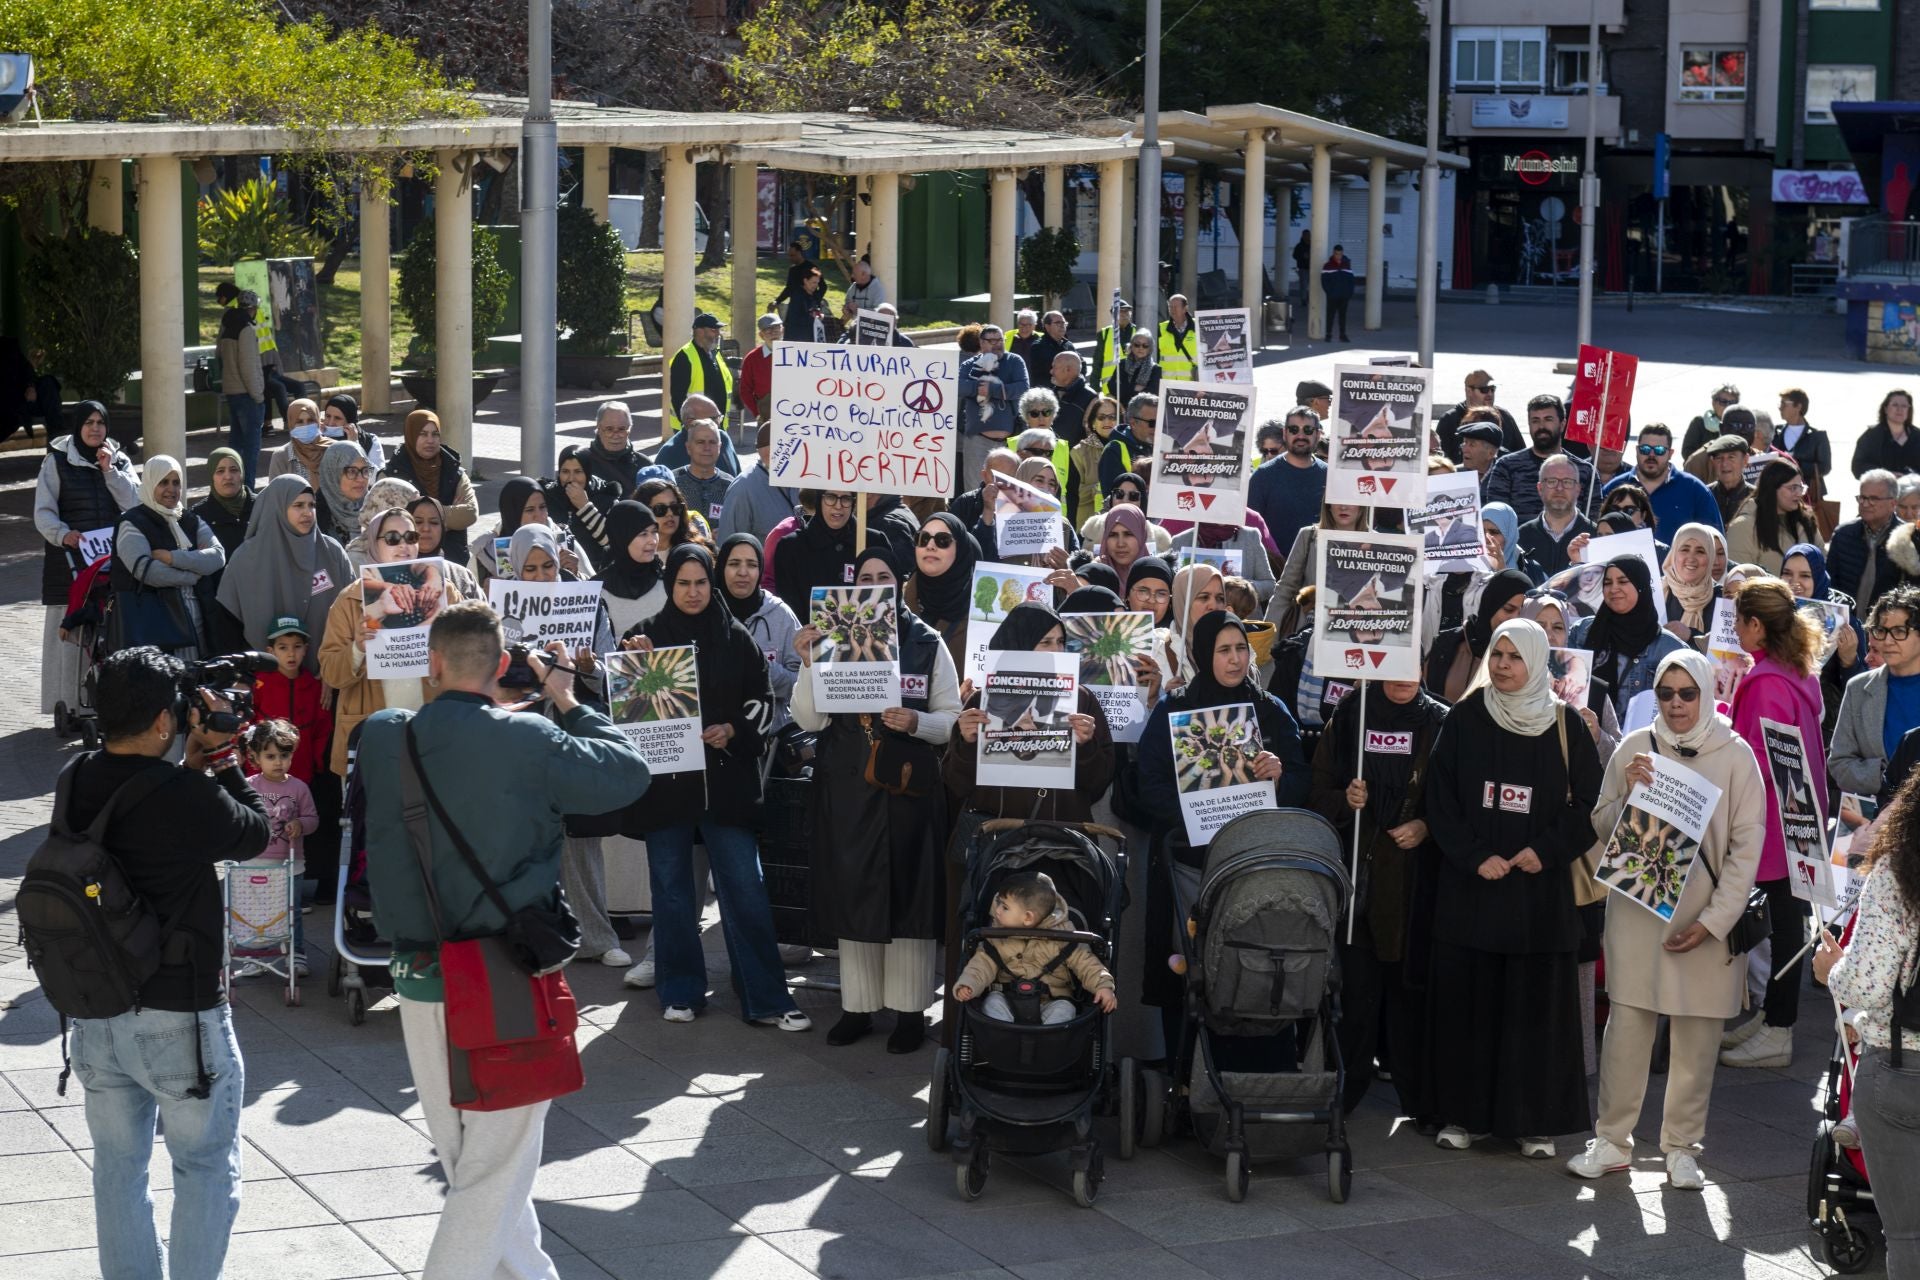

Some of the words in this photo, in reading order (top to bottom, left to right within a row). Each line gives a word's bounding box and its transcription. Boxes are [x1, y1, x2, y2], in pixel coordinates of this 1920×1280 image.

[1504, 155, 1577, 173] Munashi
[774, 346, 916, 379] INSTAURAR
[925, 361, 955, 380] EL
[1342, 380, 1375, 390] CONTRA
[1376, 381, 1387, 390] EL
[1387, 382, 1423, 393] RACISMO
[1168, 395, 1199, 406] CONTRA
[1200, 398, 1209, 407] EL
[1210, 399, 1246, 410] RACISMO
[1349, 391, 1356, 400] Y
[1356, 392, 1367, 401] LA
[1367, 392, 1415, 403] XENOFOBIA
[776, 399, 838, 421] COMO
[933, 412, 955, 430] DE
[1173, 407, 1180, 416] Y
[1180, 407, 1190, 416] LA
[1191, 408, 1238, 421] XENOFOBIA
[784, 423, 864, 444] ESTADO
[877, 430, 904, 451] NO
[913, 433, 945, 453] ES
[1004, 538, 1057, 546] OPORTUNIDADES
[1329, 547, 1364, 559] CONTRA
[1365, 550, 1376, 559] EL
[1376, 551, 1415, 563] RACISMO
[1336, 559, 1343, 569] Y
[1343, 560, 1356, 570] LA
[1356, 561, 1406, 574] XENOFOBIA
[529, 596, 552, 617] NO
[552, 594, 597, 607] SOBRAN
[552, 606, 596, 616] INMIGRANTES
[539, 620, 593, 636] SOBRAN
[1723, 619, 1733, 627] DE
[390, 632, 426, 643] NUESTRA
[1721, 627, 1730, 635] LA
[385, 641, 429, 651] VERDADER
[537, 636, 592, 650] RASTAS
[374, 650, 429, 660] NACIONALIDA
[823, 677, 889, 685] DISCRIMINACIONES
[987, 676, 1073, 689] CONCENTRACIÓN
[1103, 691, 1139, 699] EXIGIMOS
[623, 727, 651, 736] TODOS
[652, 723, 692, 733] EXIGIMOS
[639, 731, 685, 742] QUEREMOS
[1369, 733, 1408, 746] NO+
[647, 746, 685, 757] NUESTRO
[644, 755, 680, 765] ERECHO
[1655, 779, 1664, 789] EL
[1656, 770, 1689, 791] LABORAL
[1664, 784, 1674, 794] ES
[1189, 800, 1205, 809] UNA
[1205, 798, 1216, 806] DE
[1217, 796, 1231, 805] LAS
[1232, 790, 1267, 802] MAYORES
[1639, 792, 1673, 813] MAYORES
[1674, 789, 1703, 811] MODERNAS
[1687, 787, 1708, 805] SEXISMO
[1195, 799, 1264, 816] DISCRIMINACIONES
[1647, 786, 1702, 821] DISCRIMINACIONES
[1673, 809, 1686, 820] LAS
[1684, 816, 1692, 824] DE
